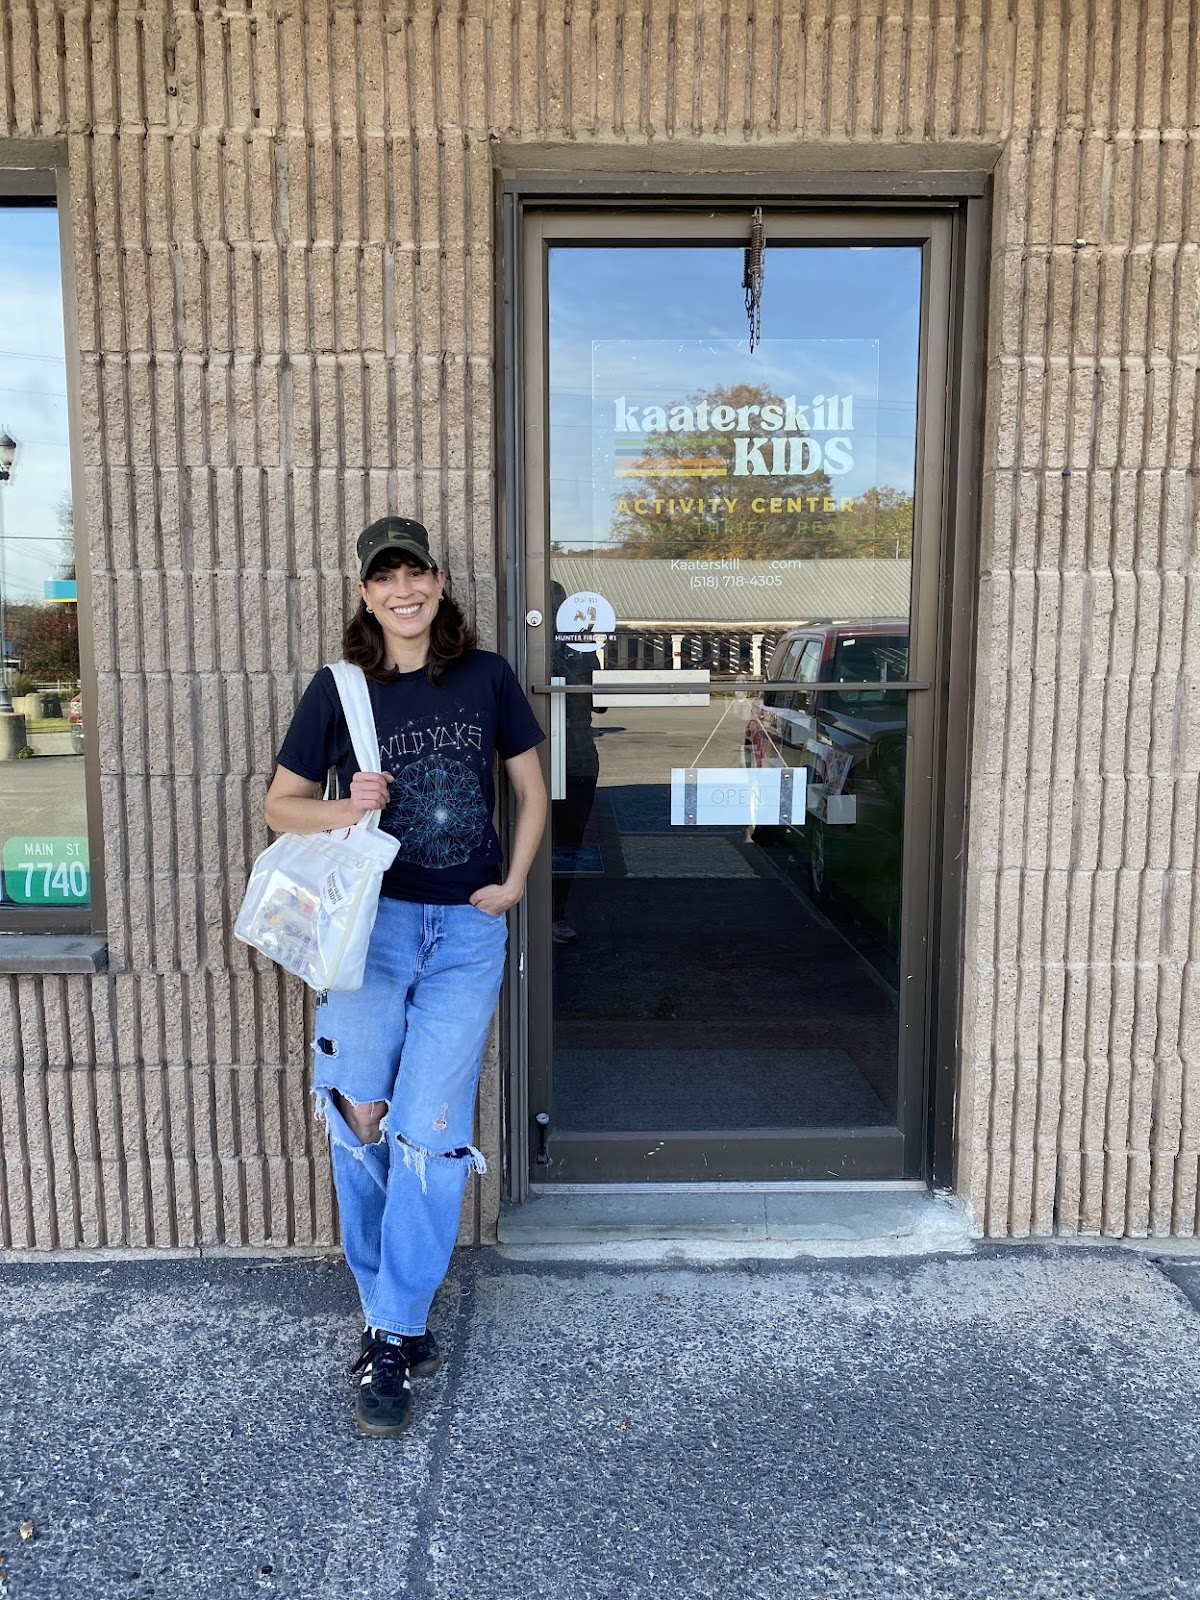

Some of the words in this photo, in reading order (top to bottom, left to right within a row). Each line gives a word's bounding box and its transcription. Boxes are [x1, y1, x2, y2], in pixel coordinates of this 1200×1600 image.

[613, 394, 855, 433] kaaterskill
[733, 437, 855, 476] KIDS
[615, 498, 738, 515] ACTIVITY
[751, 496, 855, 513] CENTER
[689, 575, 719, 588] (518)
[722, 574, 782, 587] 718-4305
[427, 722, 482, 751] YAKS
[711, 788, 762, 805] OPEN
[24, 843, 54, 856] MAIN
[66, 843, 80, 856] ST
[18, 861, 88, 898] 7740
